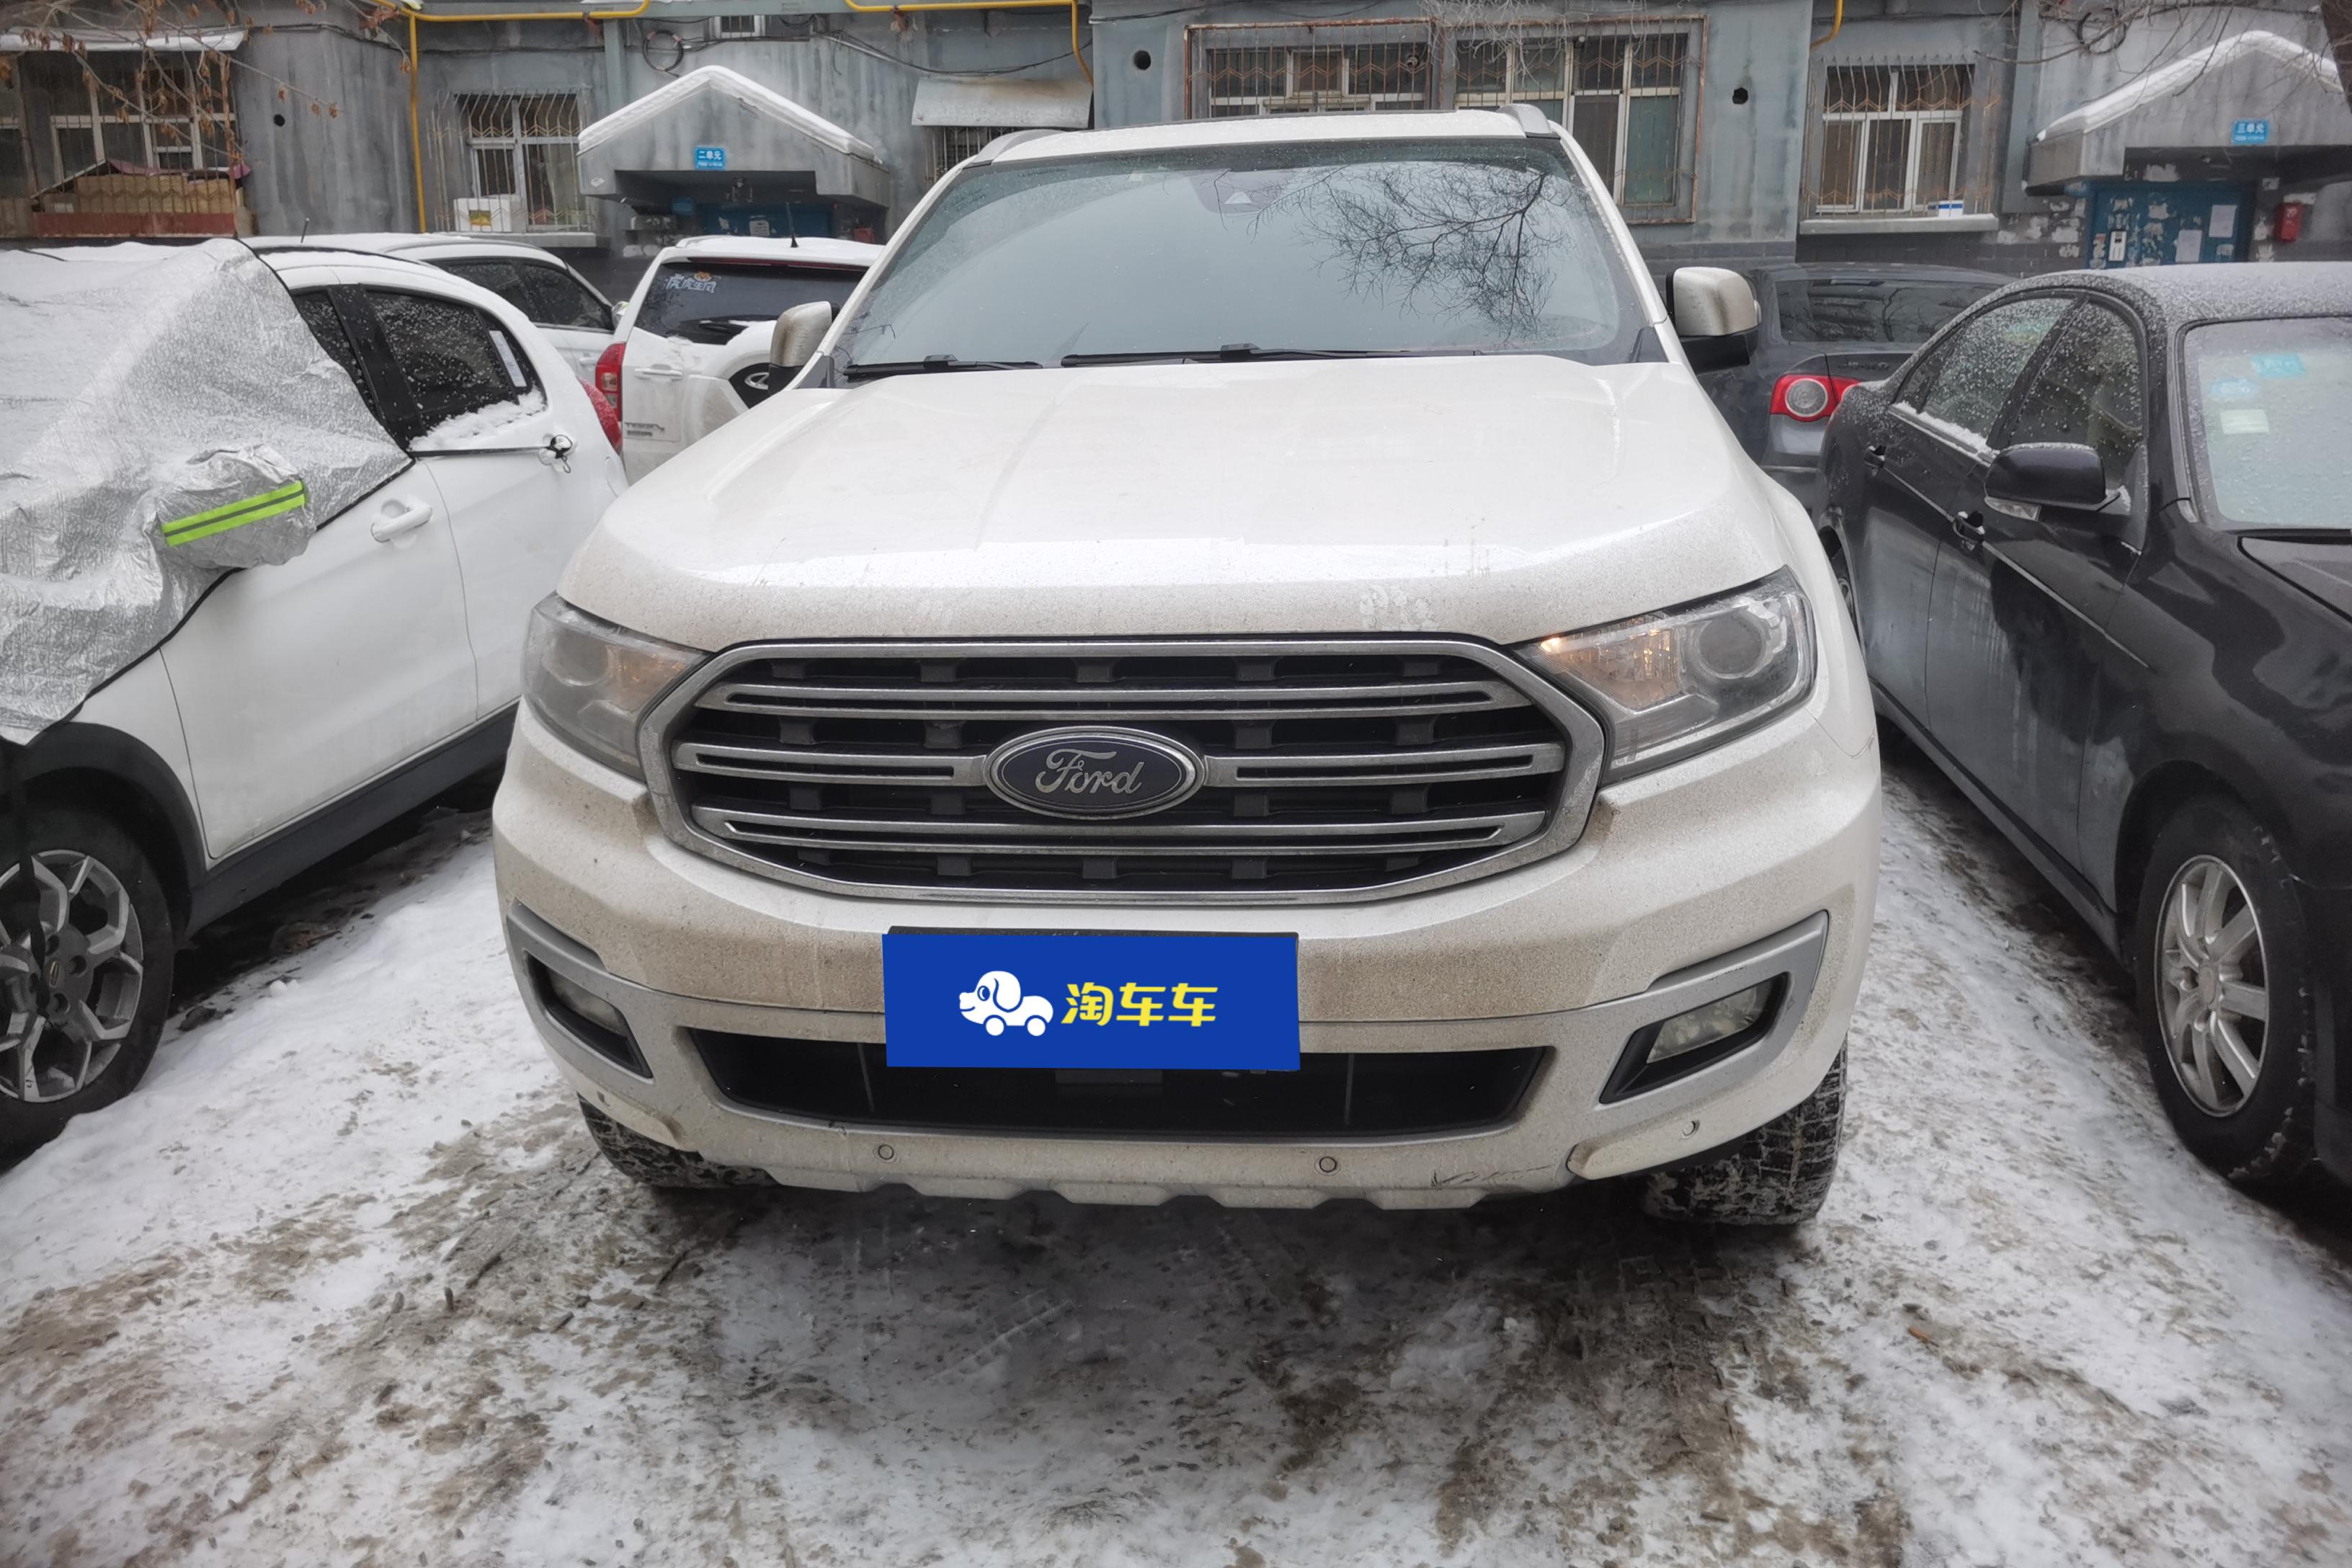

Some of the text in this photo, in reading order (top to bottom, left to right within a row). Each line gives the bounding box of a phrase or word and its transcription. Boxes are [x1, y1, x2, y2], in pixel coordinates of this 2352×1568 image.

[698, 150, 723, 160] 二单元
[666, 273, 717, 293] 虎虎生风
[1035, 748, 1145, 794] Ford
